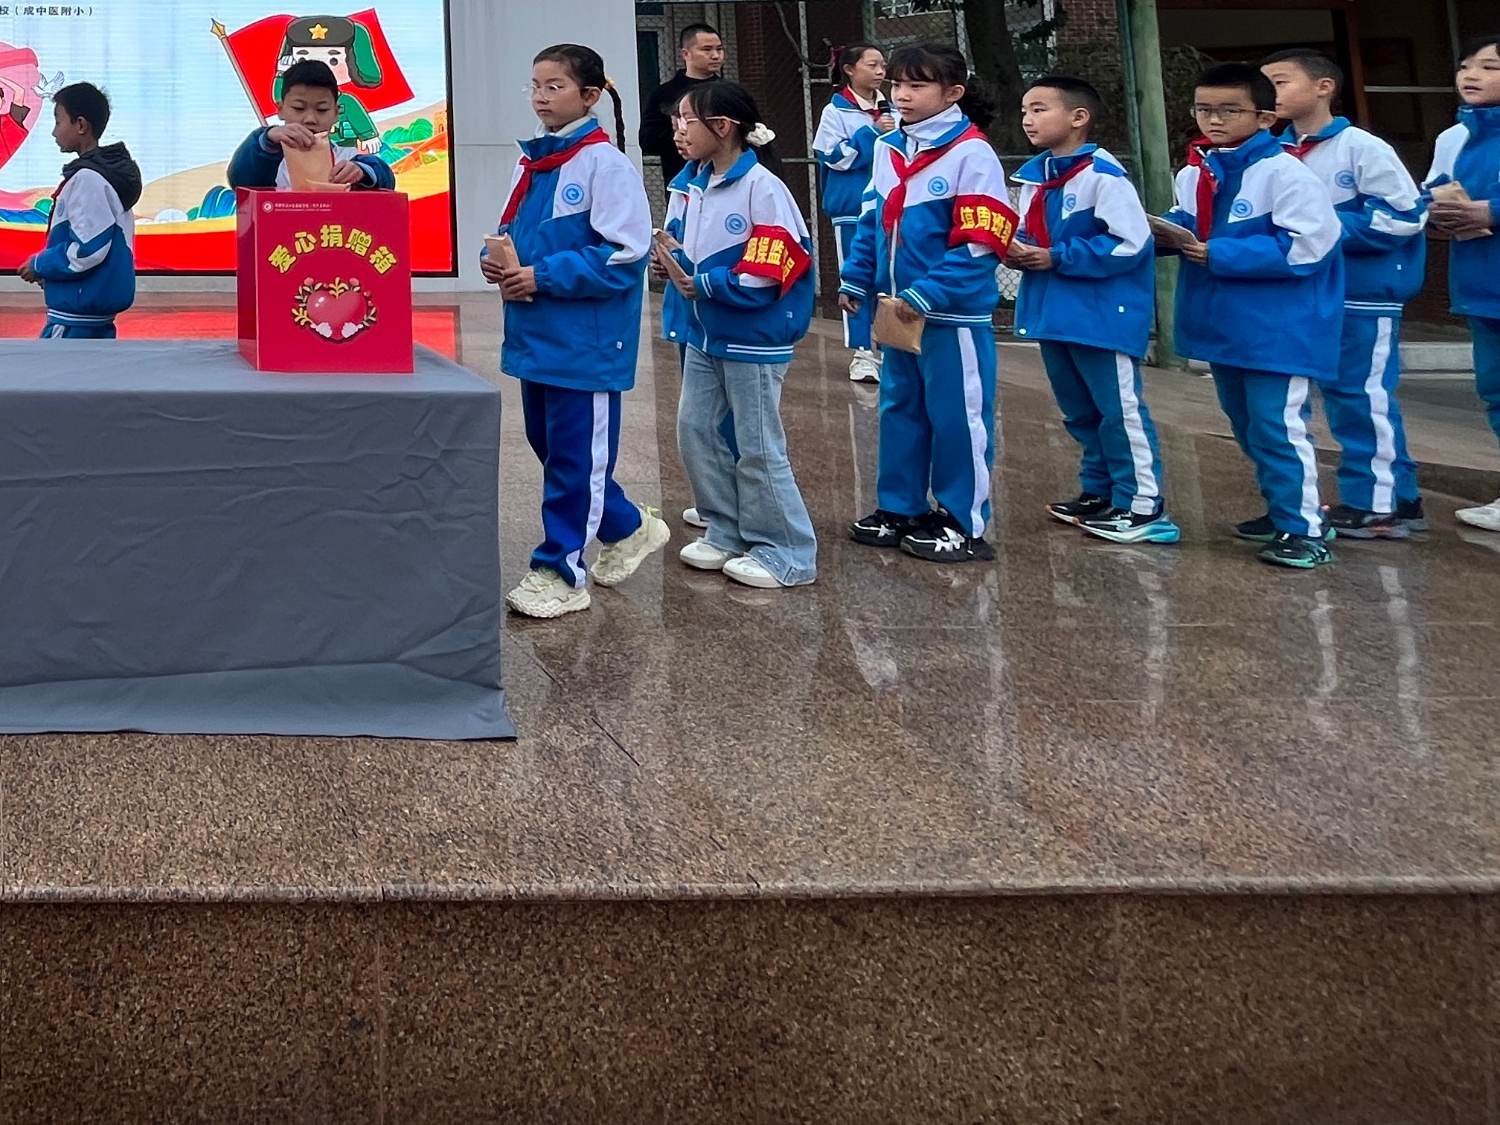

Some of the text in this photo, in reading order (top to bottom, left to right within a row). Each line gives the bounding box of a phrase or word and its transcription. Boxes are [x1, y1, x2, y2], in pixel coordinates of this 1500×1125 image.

[268, 225, 397, 274] 爱心捐赠箱
